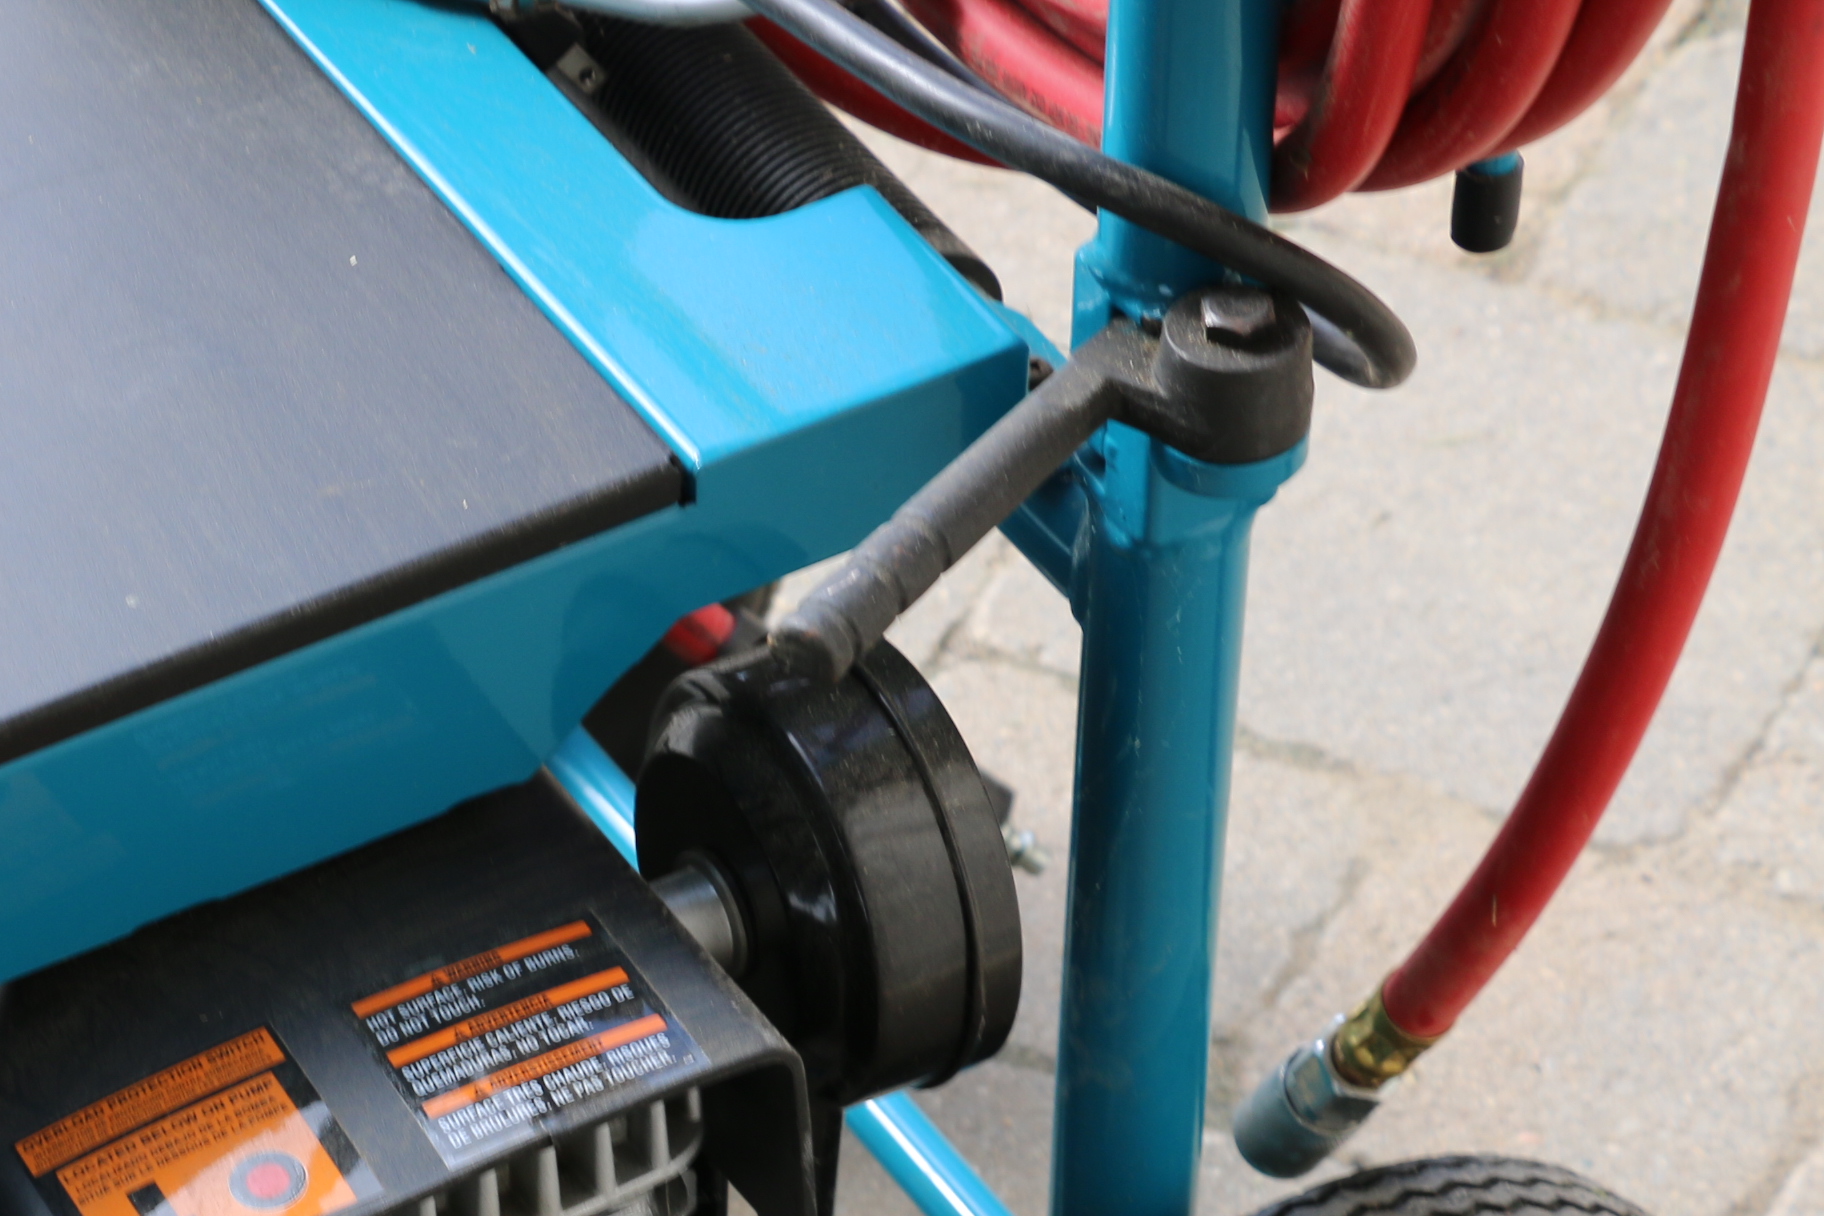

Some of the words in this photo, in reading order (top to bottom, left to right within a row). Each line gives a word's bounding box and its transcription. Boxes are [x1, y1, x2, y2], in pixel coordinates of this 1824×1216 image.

[366, 1009, 396, 1033] HOT
[466, 969, 504, 993] RISK
[503, 960, 523, 980] OF
[375, 1027, 399, 1047] DO
[399, 1013, 429, 1037] NOT
[402, 1036, 486, 1082] SUPERFICIE
[557, 991, 611, 1022] RIESGO
[611, 983, 635, 1003] DE
[438, 1093, 504, 1134] SURFACE
[606, 1032, 671, 1066] RISQUES
[515, 1034, 540, 1055] NO
[22, 1107, 104, 1152] OVERLOAD
[108, 1062, 203, 1110] PROTECTION
[207, 1033, 265, 1063] SWITCH
[63, 1141, 137, 1185] LOCATED
[140, 1113, 198, 1145] BELOW
[202, 1100, 225, 1117] ON
[229, 1078, 273, 1104] PUMP
[448, 1129, 472, 1149] DE
[550, 1086, 575, 1107] NE
[572, 1074, 604, 1099] PAS
